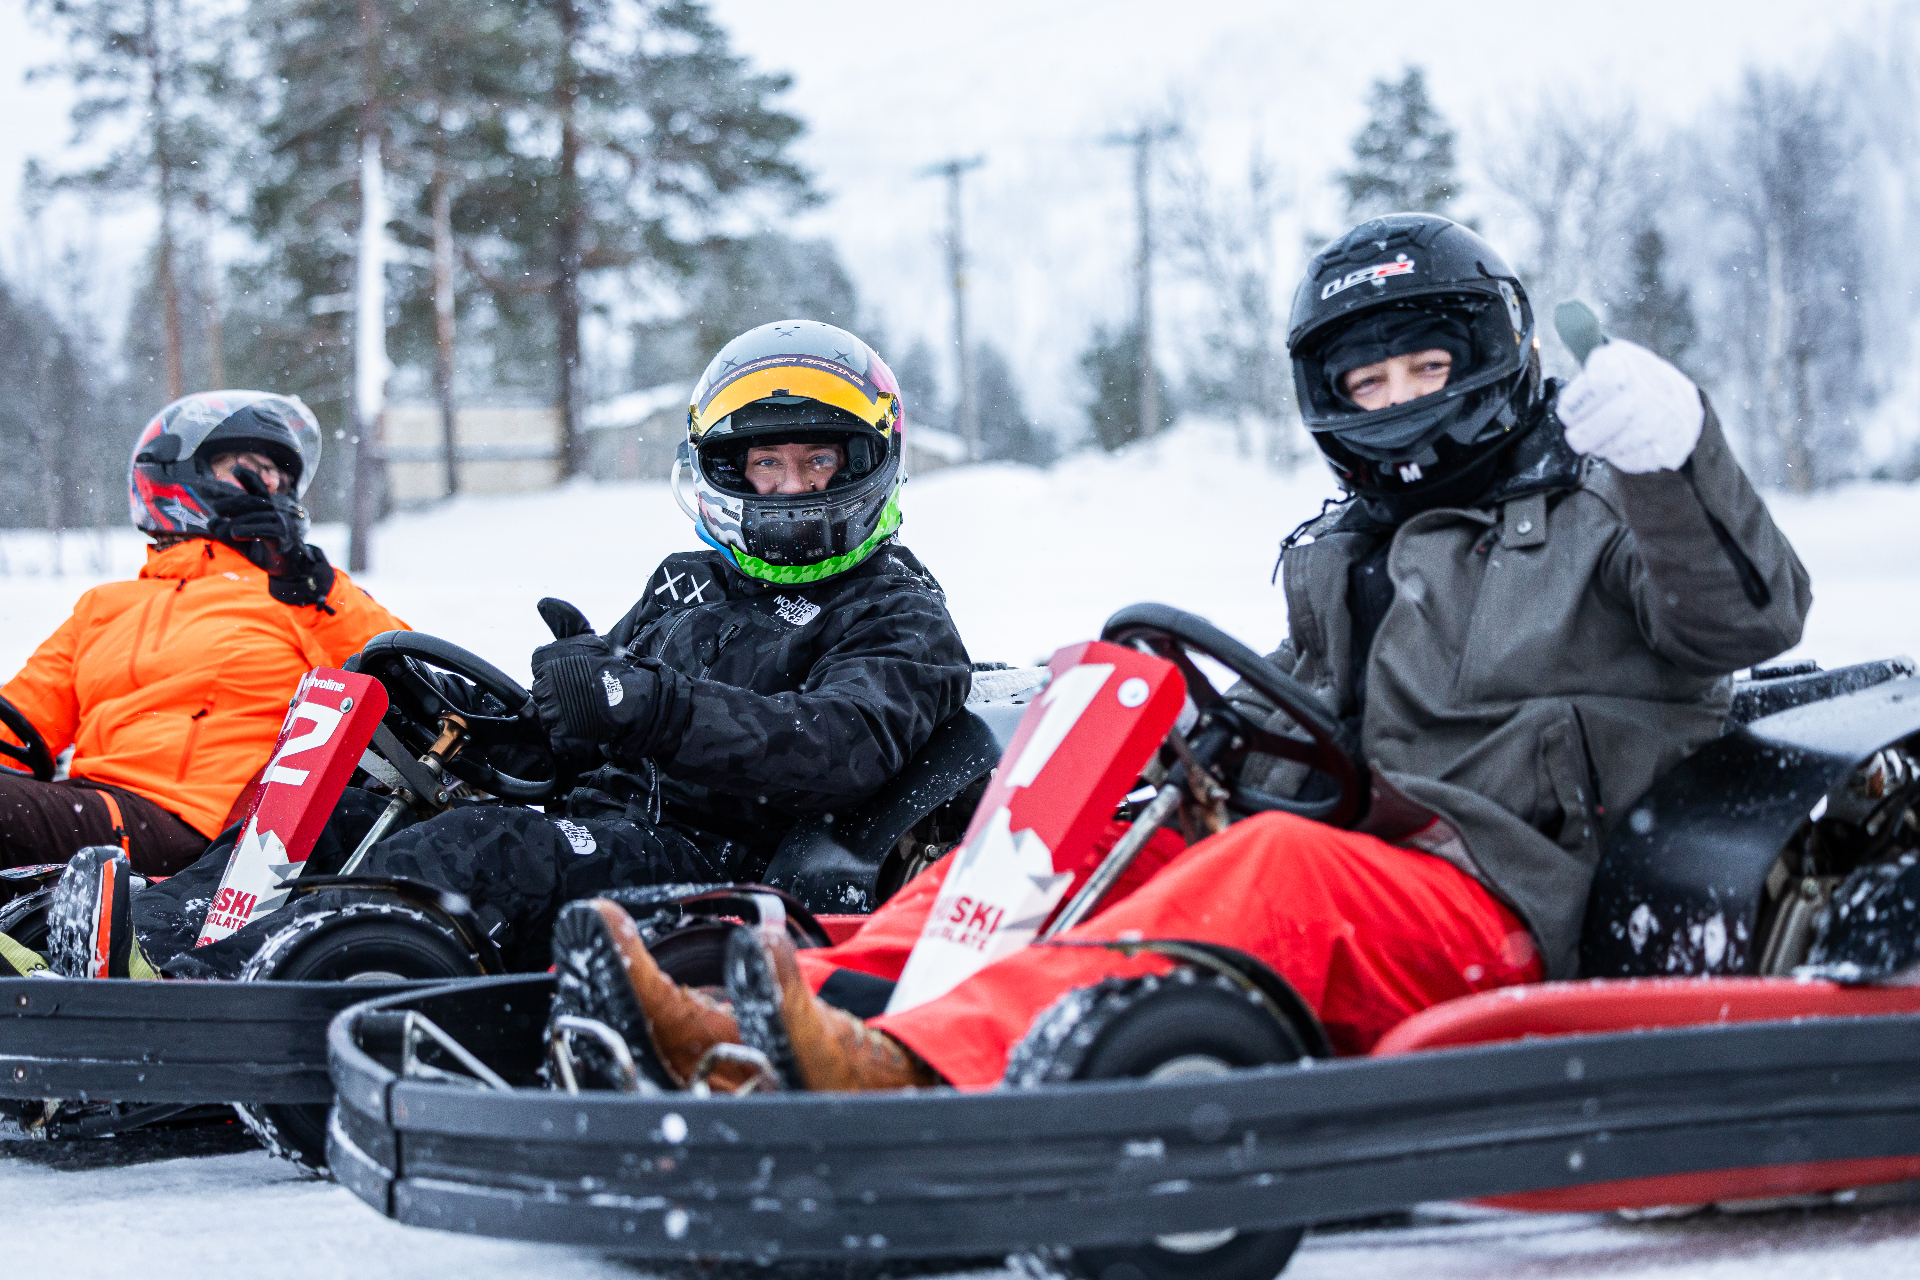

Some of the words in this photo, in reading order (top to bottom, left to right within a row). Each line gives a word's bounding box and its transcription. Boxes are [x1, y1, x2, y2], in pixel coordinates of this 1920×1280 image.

[800, 358, 865, 387] RACING
[773, 594, 808, 618] NORTH
[260, 701, 344, 787] 2
[1005, 662, 1116, 788] 1
